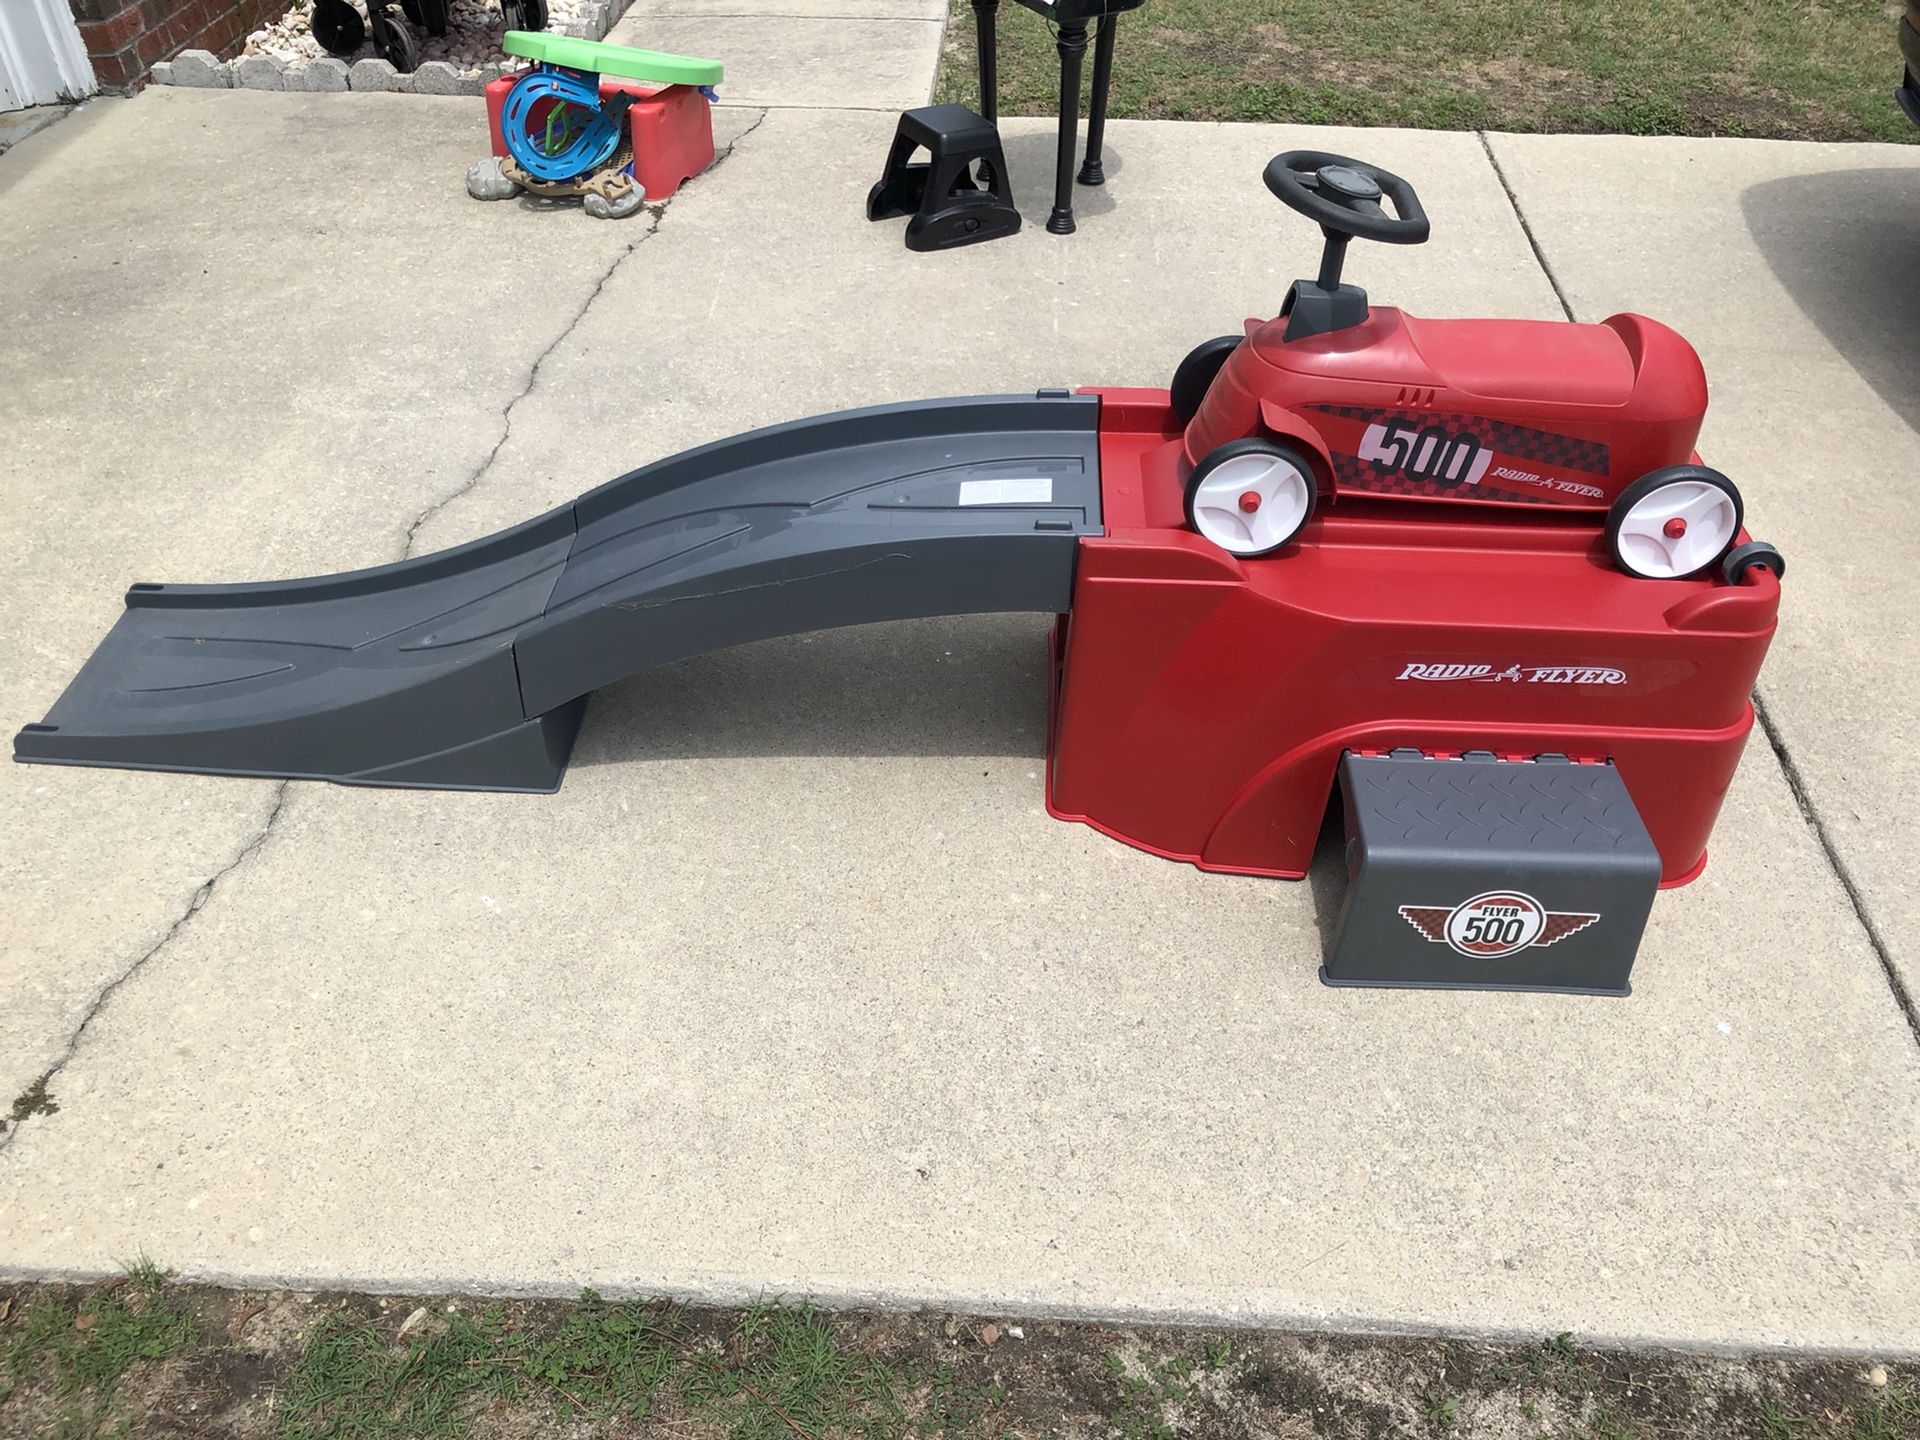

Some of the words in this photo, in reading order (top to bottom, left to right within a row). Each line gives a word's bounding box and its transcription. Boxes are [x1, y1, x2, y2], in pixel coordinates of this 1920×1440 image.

[1371, 417, 1482, 488] 500
[1491, 466, 1539, 481] RADIO
[1554, 481, 1604, 498] FLYER
[1396, 663, 1494, 681] RADIO
[1526, 667, 1627, 685] FLYER
[1482, 906, 1519, 917] FLYER
[1462, 917, 1525, 944] 500
